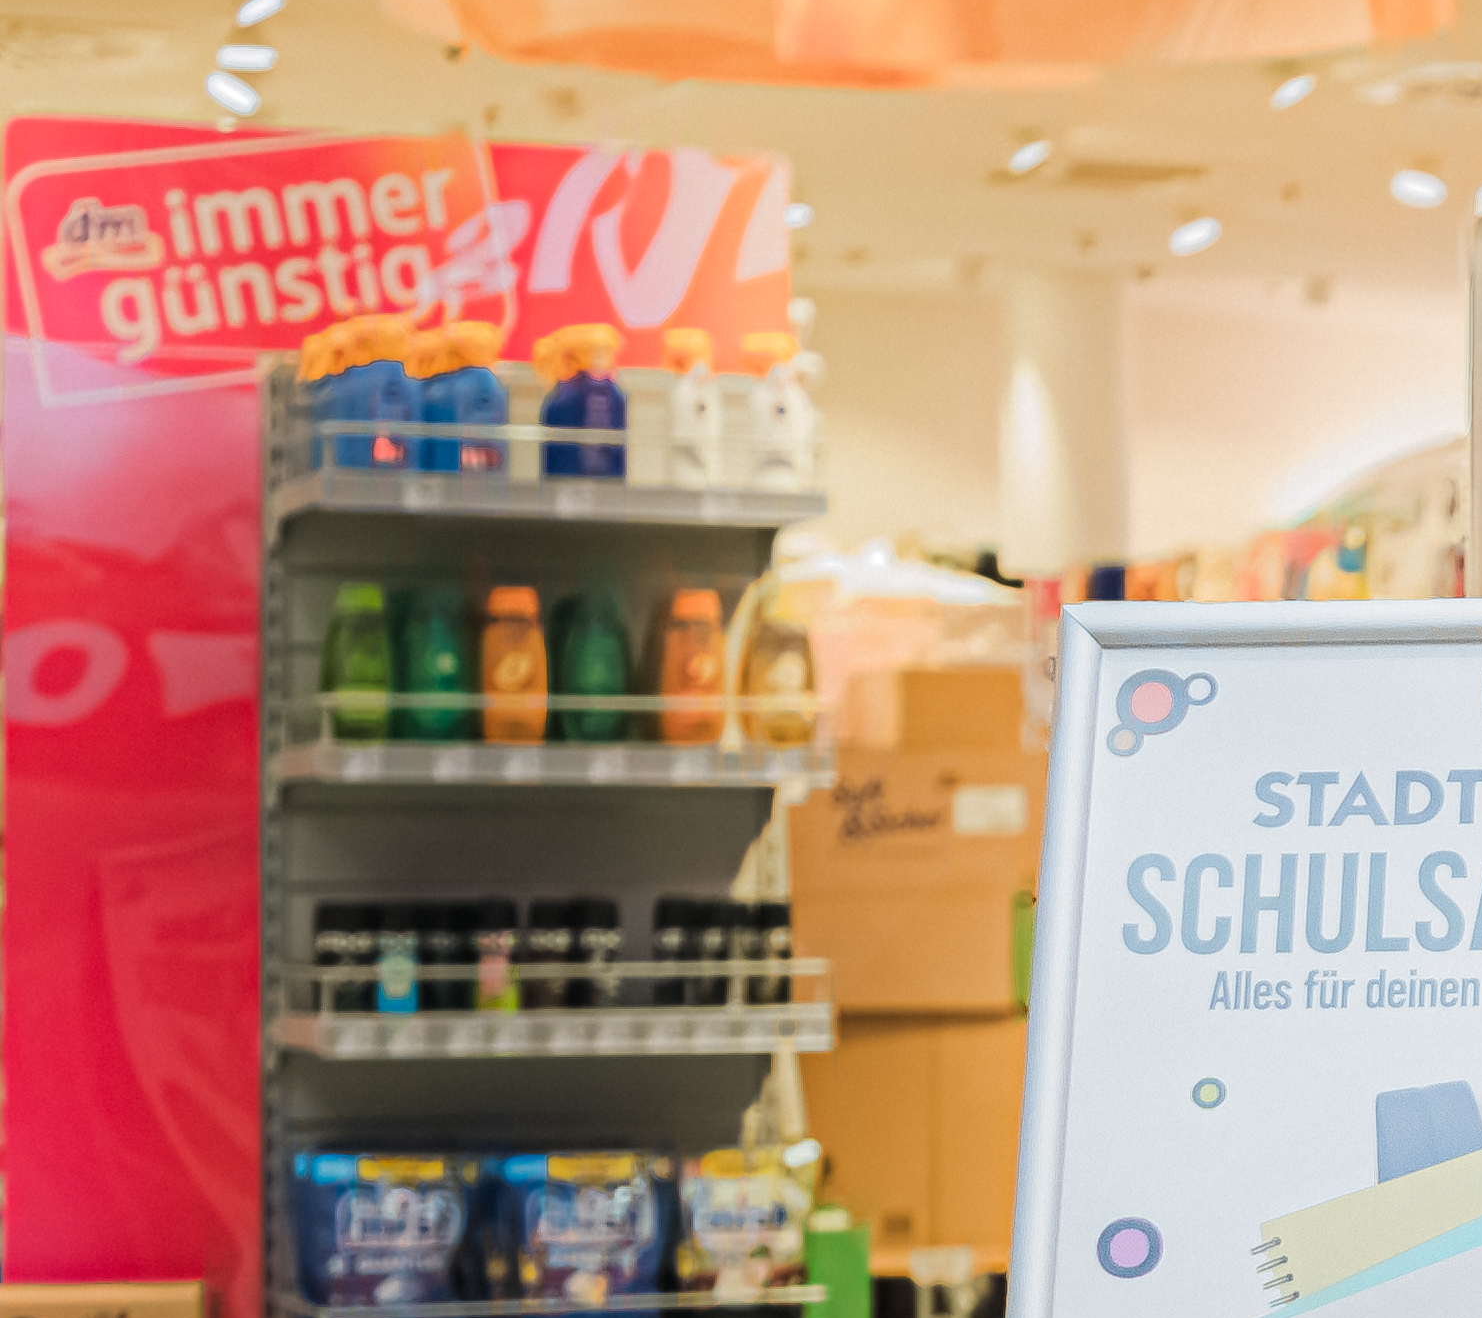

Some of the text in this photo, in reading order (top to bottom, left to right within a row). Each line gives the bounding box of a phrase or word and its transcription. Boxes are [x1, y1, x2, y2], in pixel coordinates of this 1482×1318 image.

[165, 167, 454, 257] immer
[102, 244, 440, 364] günstig
[1208, 969, 1293, 1011] Alles
[1304, 969, 1356, 1009] für
[1365, 967, 1480, 1009] deinen
